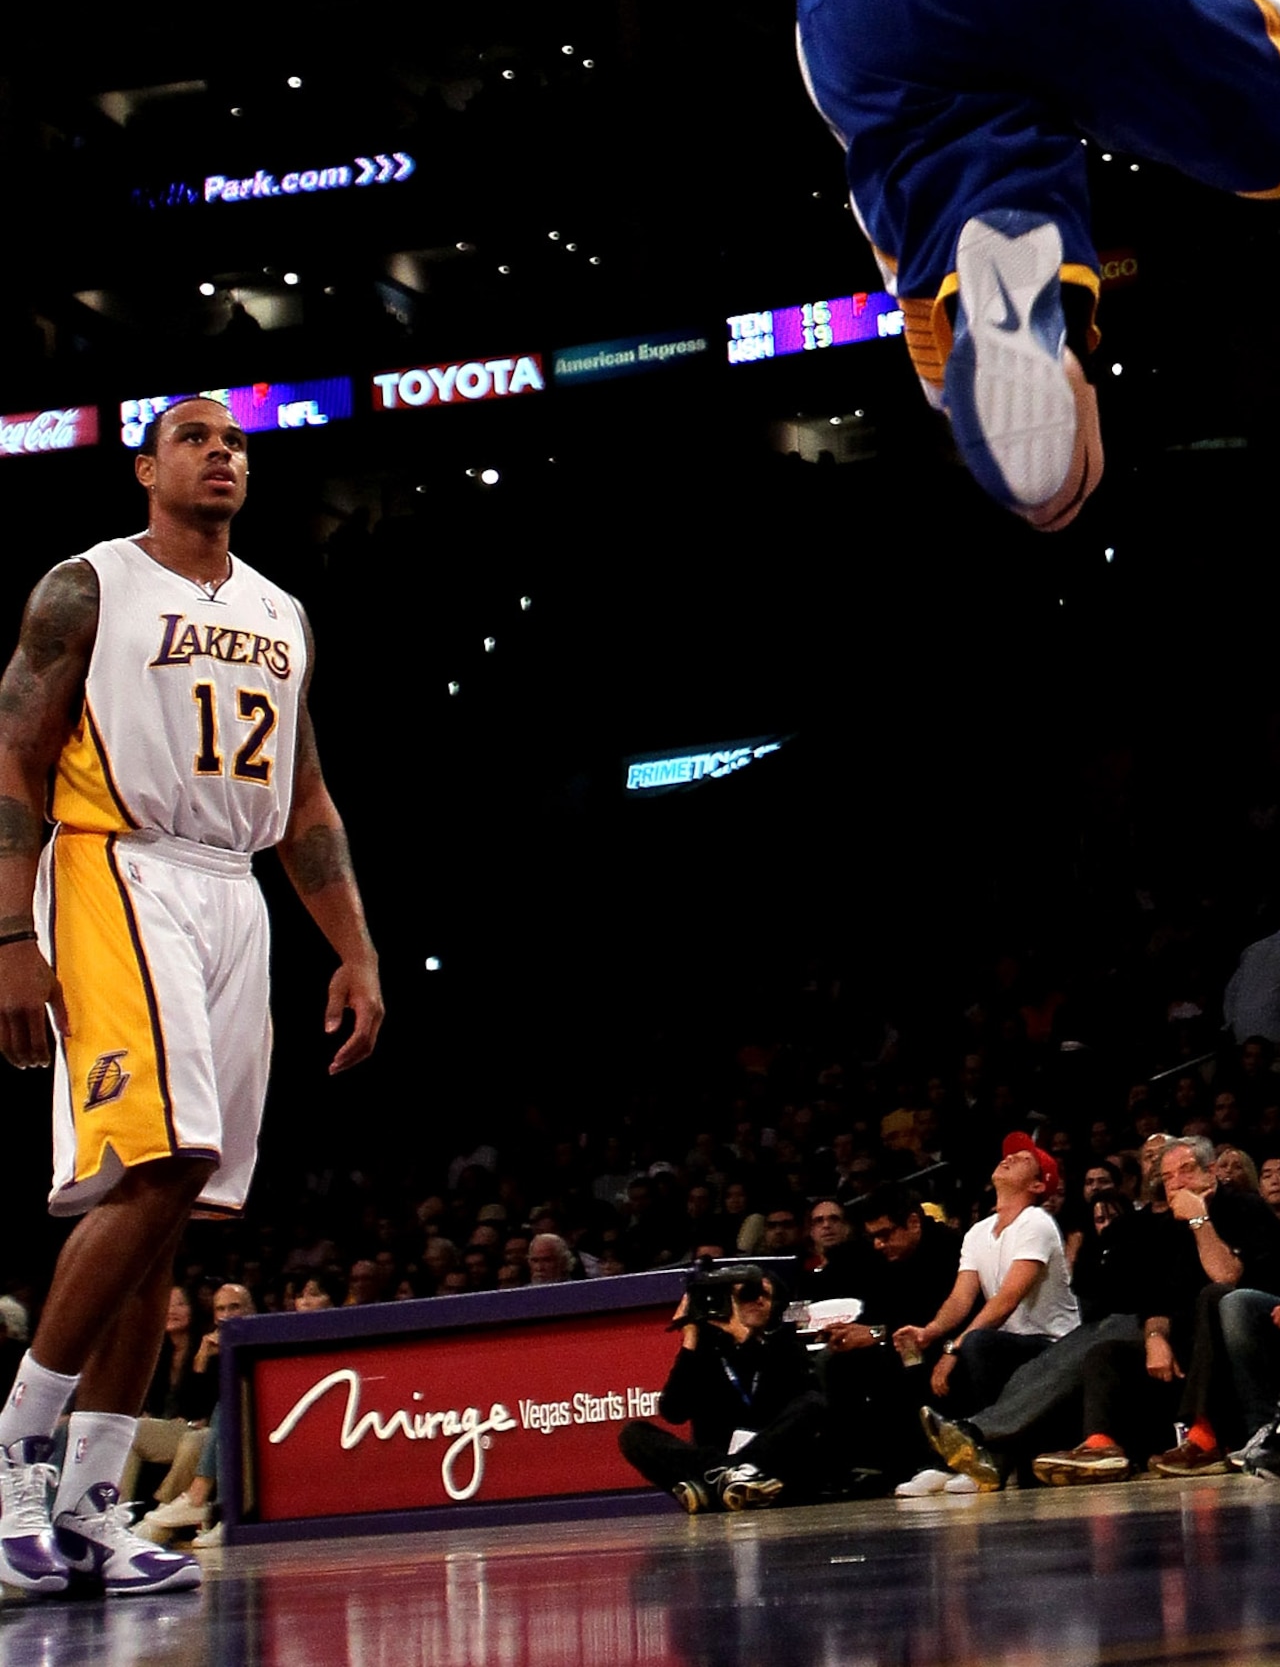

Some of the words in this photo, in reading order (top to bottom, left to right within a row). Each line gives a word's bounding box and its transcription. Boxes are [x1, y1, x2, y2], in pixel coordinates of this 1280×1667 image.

[726, 310, 774, 340] TEN
[801, 300, 832, 328] 16
[802, 323, 833, 351] 19
[555, 349, 635, 376] American
[638, 337, 707, 360] Express
[373, 356, 546, 409] TOYOTA
[277, 400, 329, 429] NFL
[149, 613, 291, 680] LAKERS
[192, 680, 278, 787] 12
[268, 1368, 517, 1501] Mirage
[518, 1399, 571, 1434] Vegas
[573, 1391, 626, 1424] Starts
